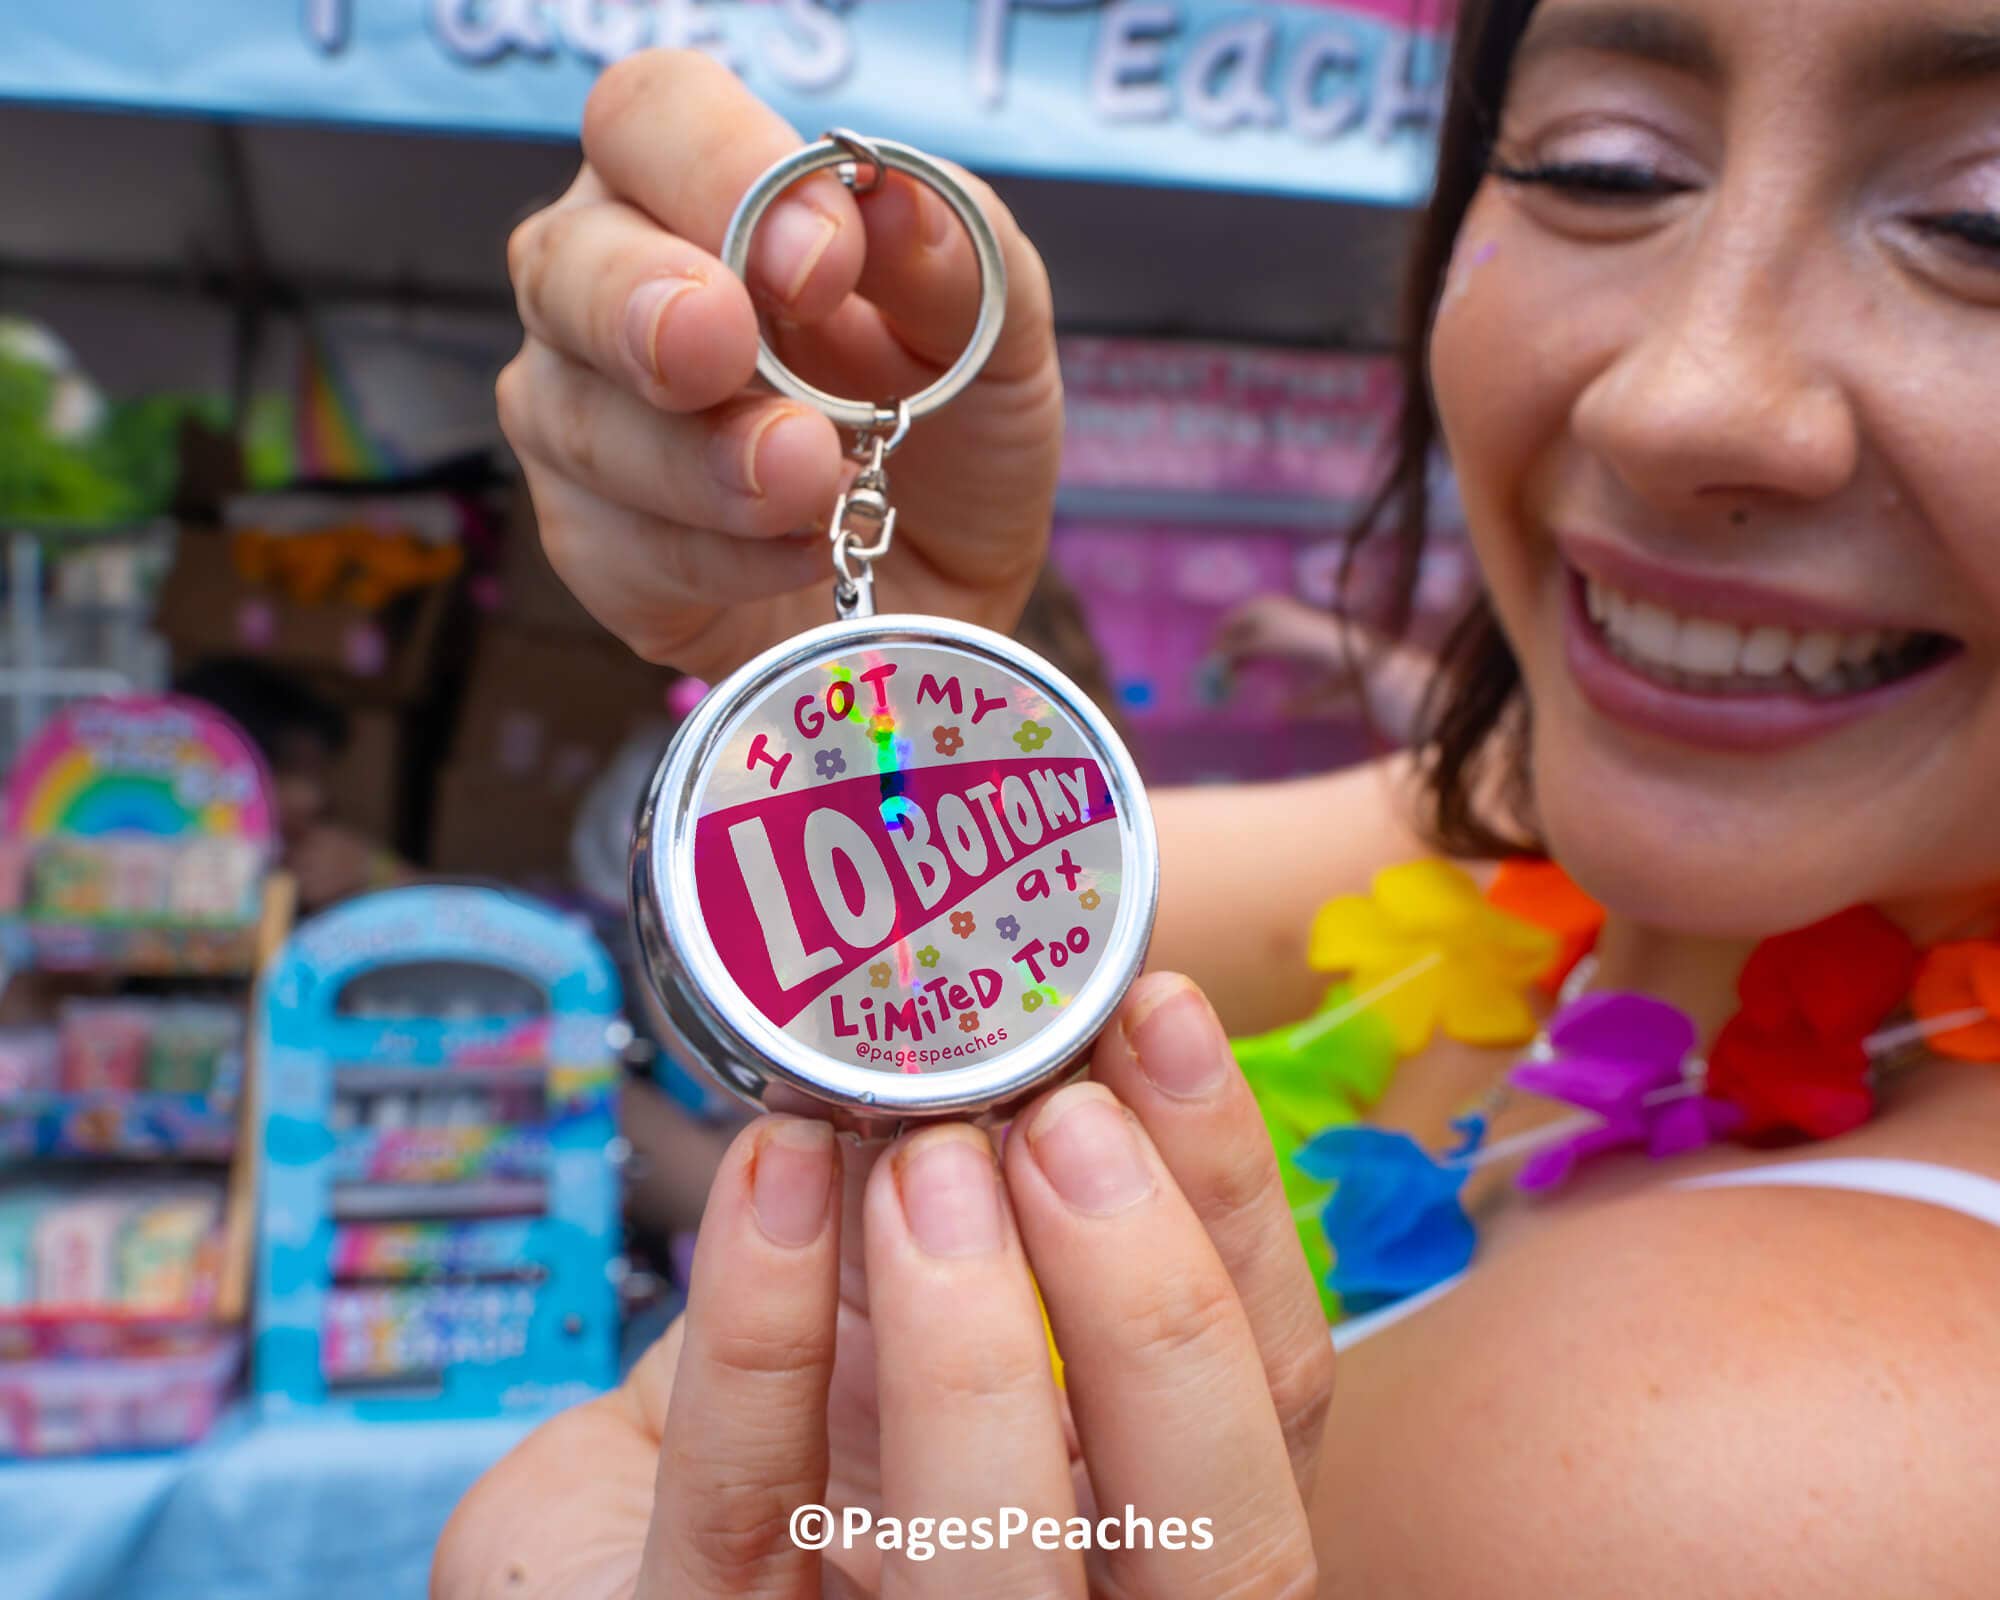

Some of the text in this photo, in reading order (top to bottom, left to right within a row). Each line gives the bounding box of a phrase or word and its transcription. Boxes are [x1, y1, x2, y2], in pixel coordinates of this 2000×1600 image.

[746, 663, 1008, 790] I GOT MY
[727, 766, 1092, 993] LOBOTOMY
[1016, 849, 1083, 903] at
[855, 1027, 1009, 1066] @pagespeaches
